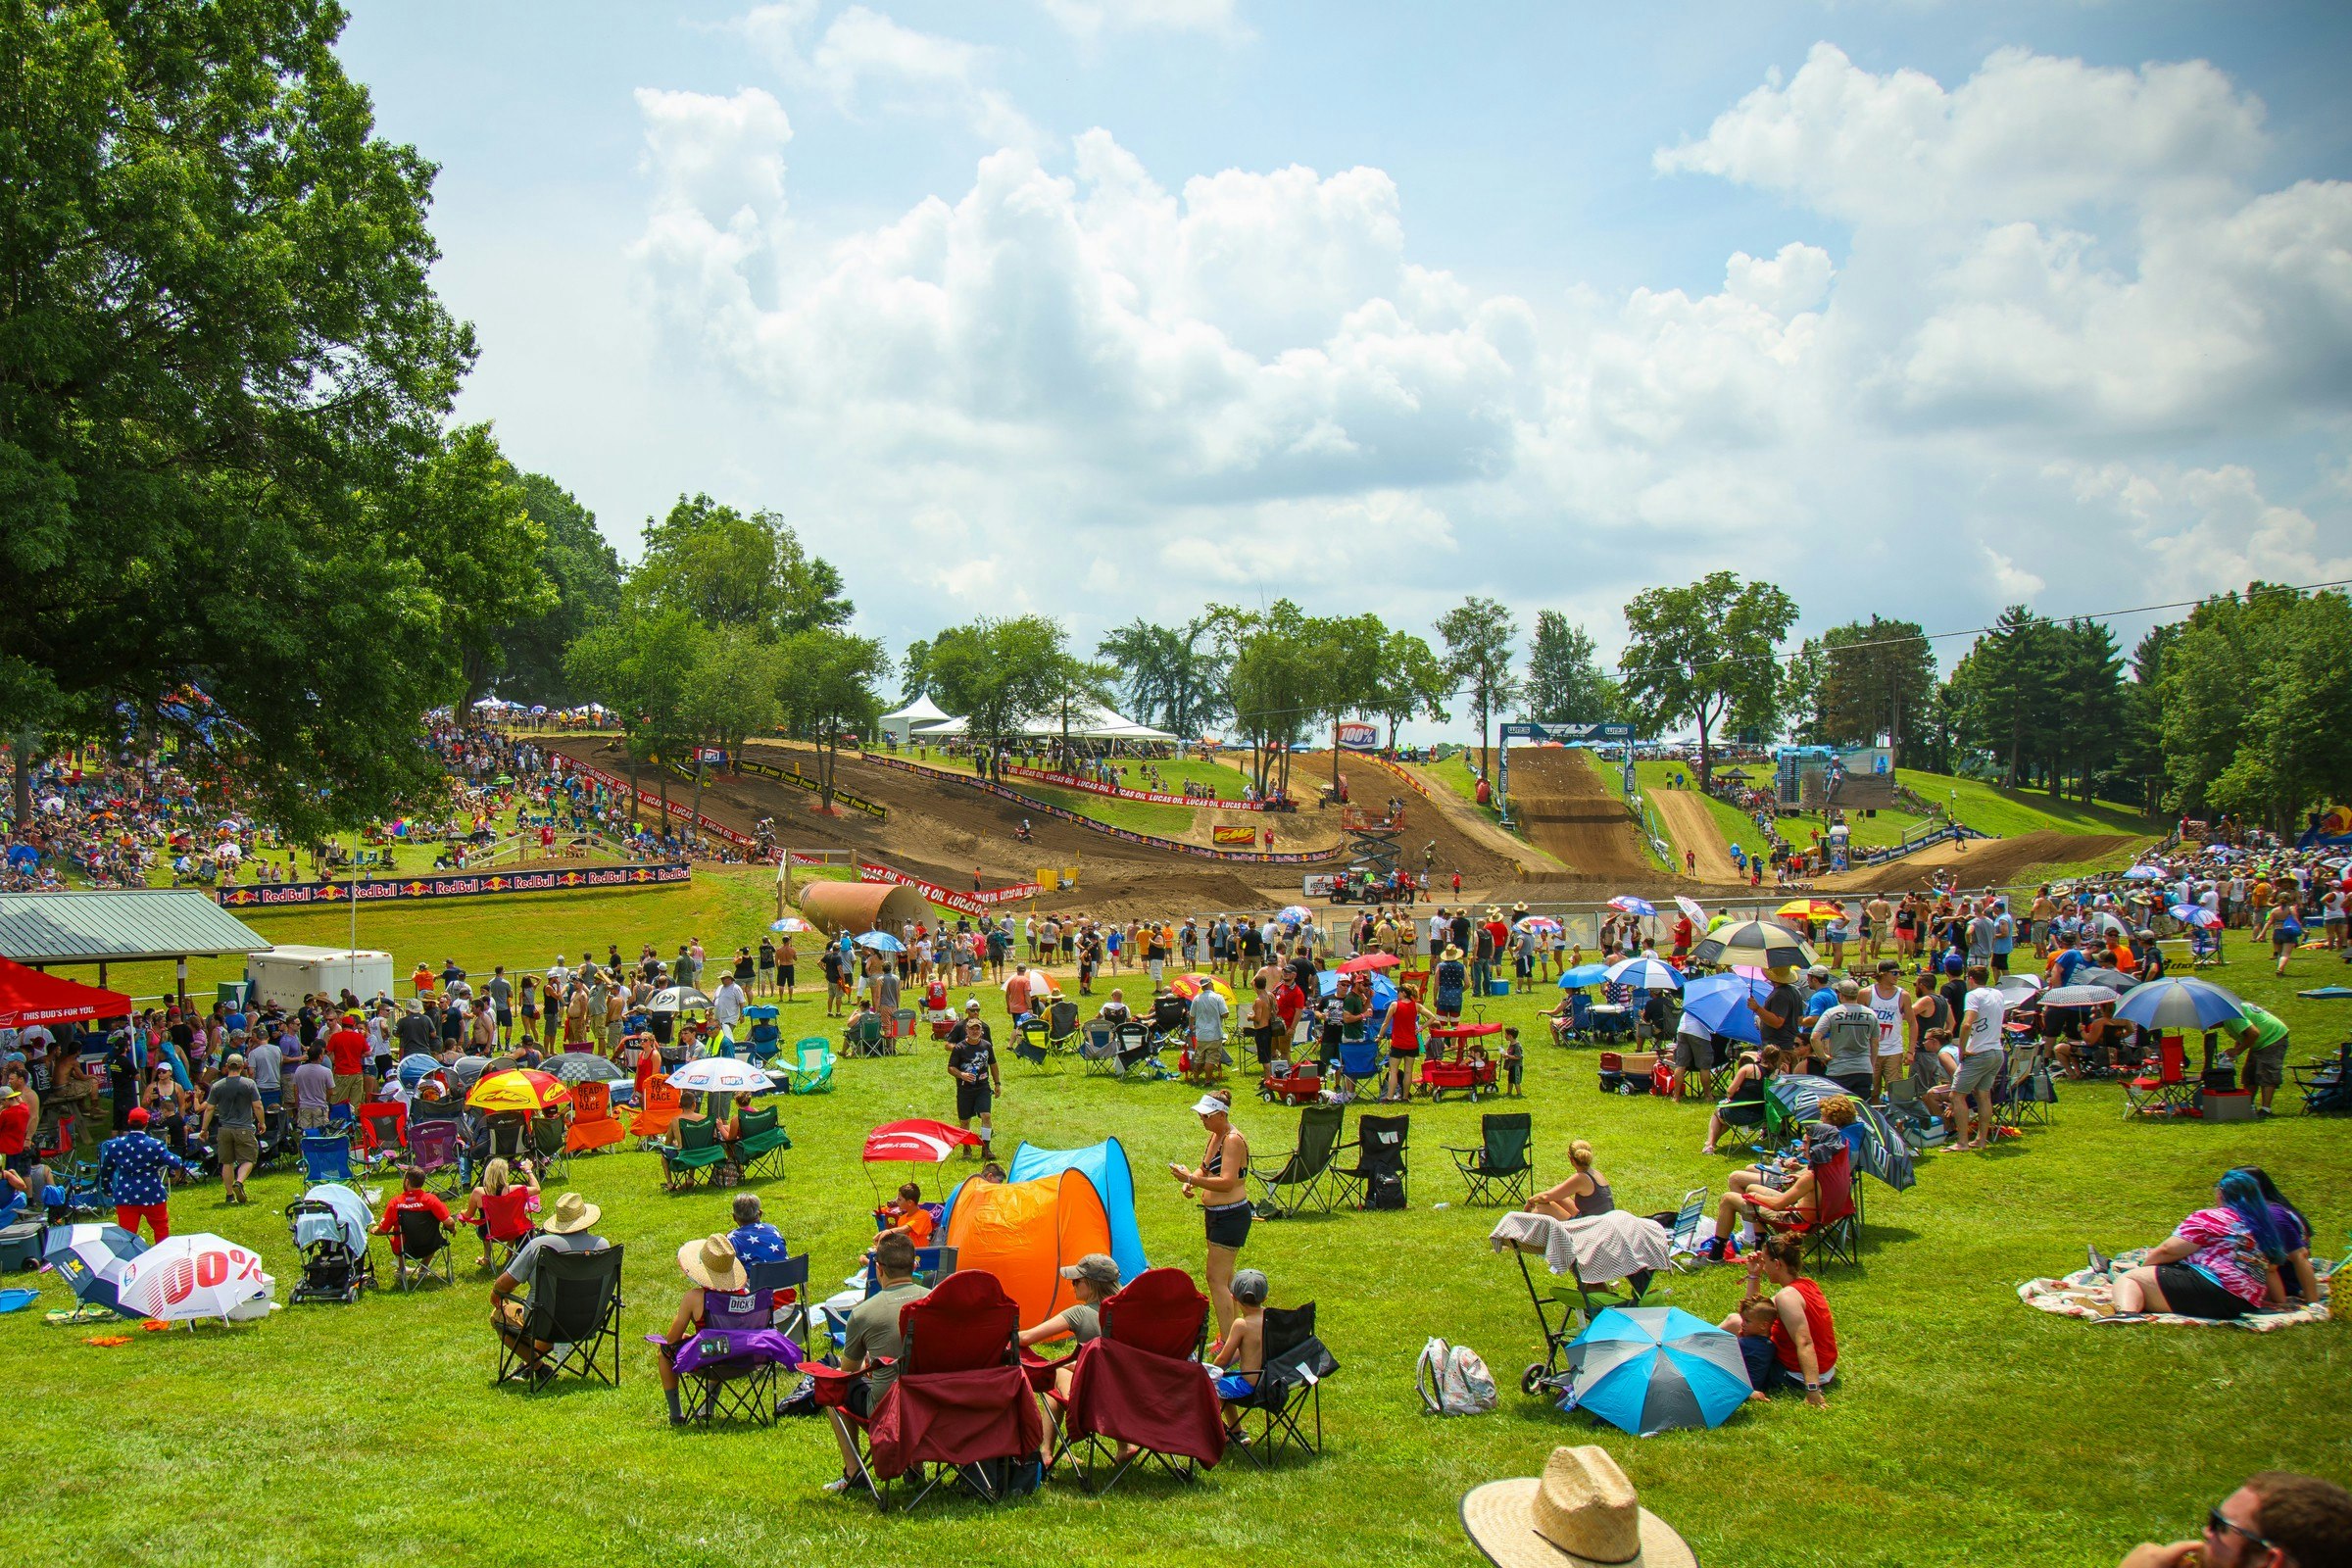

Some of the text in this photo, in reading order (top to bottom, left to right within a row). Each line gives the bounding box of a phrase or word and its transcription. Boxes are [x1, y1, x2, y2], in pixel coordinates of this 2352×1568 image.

[1342, 727, 1373, 743] 100%
[1019, 768, 1035, 777] LUCAS
[1076, 780, 1098, 790] LUCAS
[1098, 784, 1109, 793] OIL
[1135, 791, 1147, 800] OIL
[1149, 794, 1172, 804] LUCAS
[1172, 796, 1184, 805] OIL
[1186, 799, 1207, 808] LUCAS
[1221, 801, 1242, 809] LUCAS
[592, 768, 608, 784] LUCAS
[643, 796, 662, 808] LUCAS
[672, 804, 694, 819] LUCAS
[705, 819, 723, 837] LUCAS
[723, 830, 733, 840] OIL
[931, 888, 945, 904] OIL
[947, 894, 976, 912] LUCAS
[1000, 888, 1015, 900] LUCAS
[23, 1011, 39, 1021] THIS
[41, 1009, 63, 1019] BUD'S
[64, 1007, 78, 1016] FOR
[1835, 1011, 1872, 1021] SHIFT
[92, 1064, 107, 1074] WE
[578, 1086, 604, 1096] READY
[651, 1093, 671, 1102] RACE
[580, 1102, 600, 1111] RACE
[139, 1249, 263, 1319] 100%
